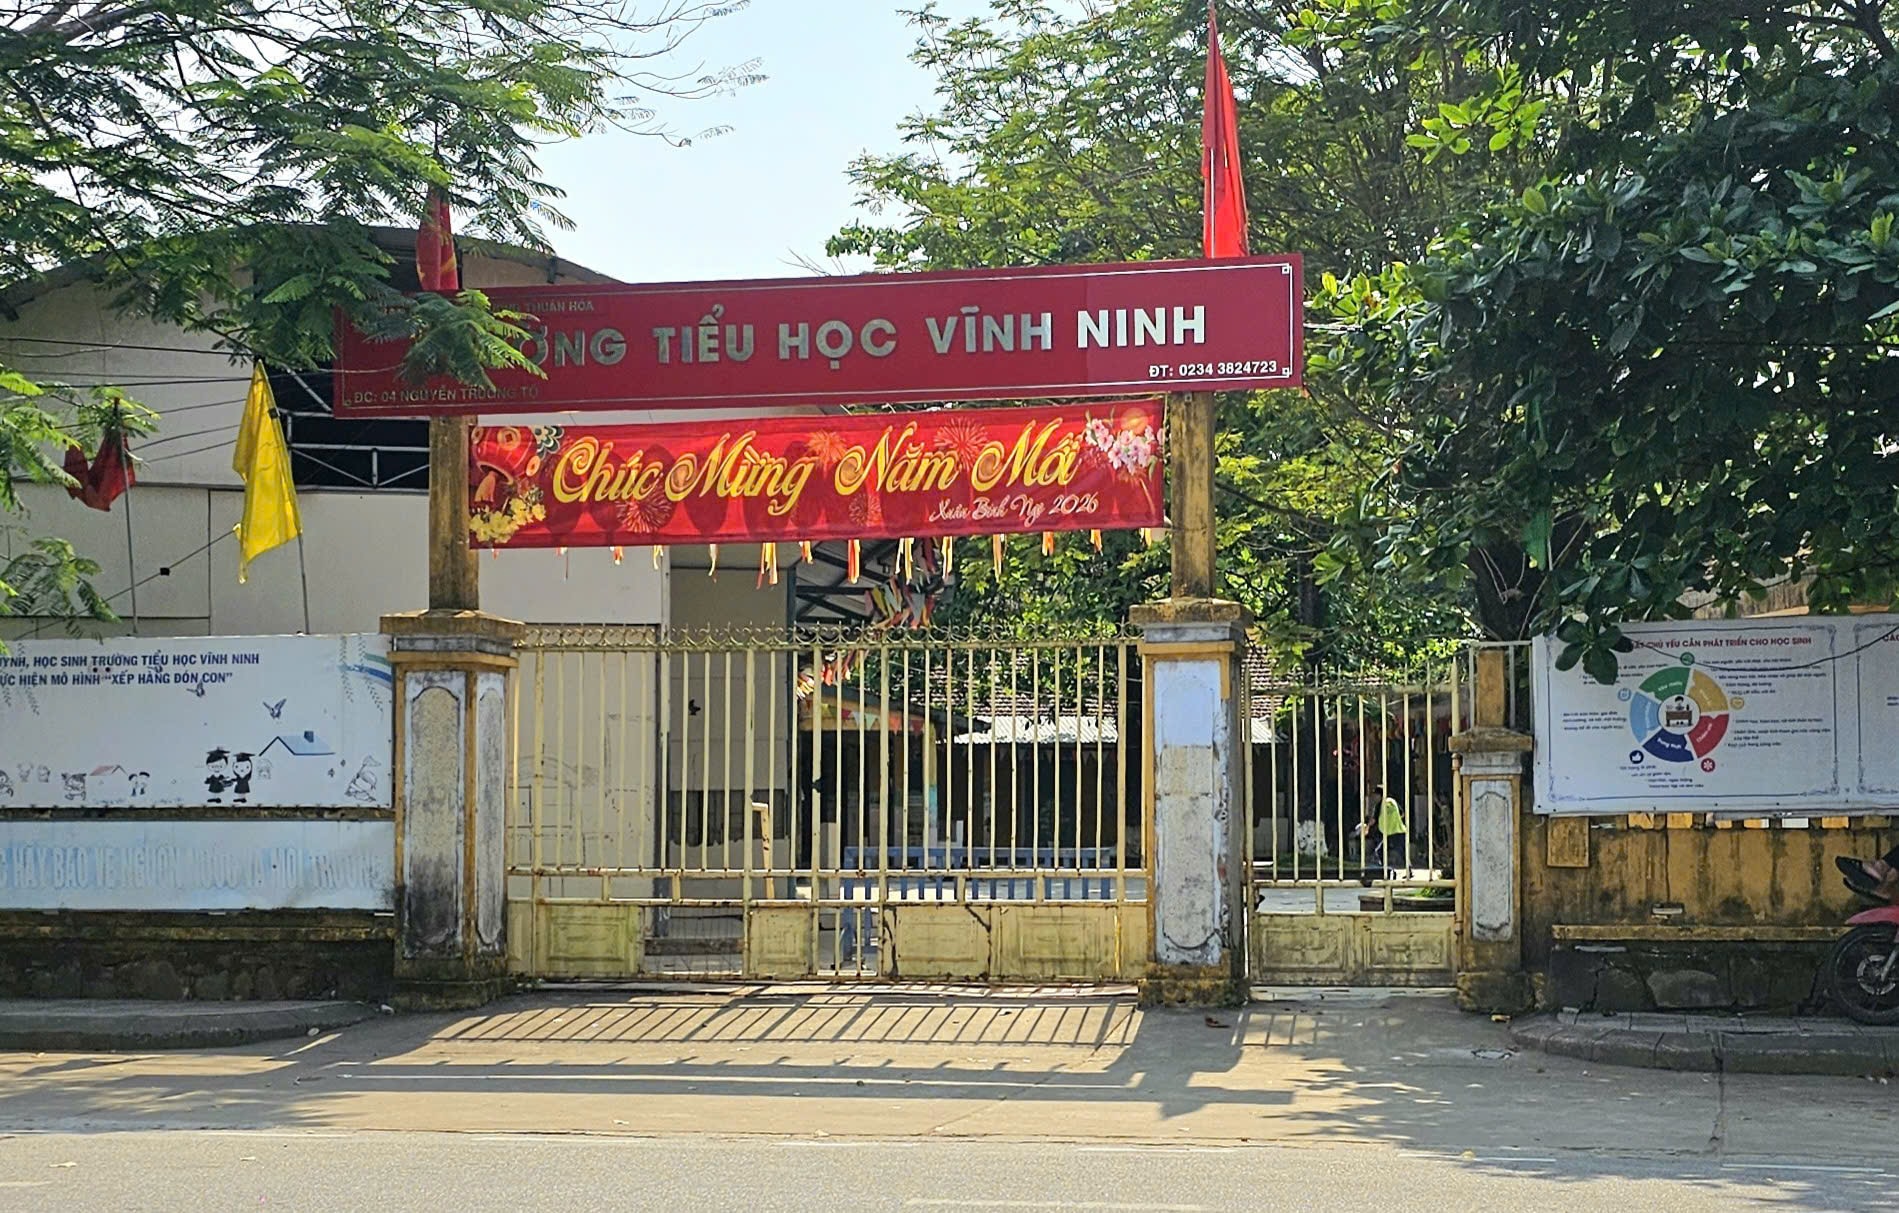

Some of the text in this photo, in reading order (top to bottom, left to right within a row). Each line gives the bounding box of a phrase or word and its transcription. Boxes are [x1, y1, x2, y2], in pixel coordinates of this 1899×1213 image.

[653, 303, 755, 365] TIỂU
[778, 317, 897, 370] HỌC
[925, 305, 1053, 354] VĨNH
[1076, 305, 1206, 348] NINH
[1148, 360, 1277, 377] ĐT: 0234 3824723
[354, 391, 378, 403] ĐC:
[381, 390, 396, 403] 04
[552, 417, 1087, 516] Chúc Mừng Năm Mới
[929, 498, 970, 522] Xuân
[1048, 491, 1099, 515] 2026
[1703, 637, 1724, 647] PHÁT
[1749, 638, 1769, 646] CHO
[1770, 637, 1789, 647] HỌC
[1792, 636, 1812, 645] SINH
[34, 656, 58, 669] HỌC
[61, 655, 88, 667] SINH
[91, 652, 138, 667] TRƯỜNG
[141, 649, 169, 666] TIỂU
[172, 653, 197, 668] HỌC
[200, 652, 228, 665] VĨNH
[232, 653, 260, 665] NINH
[19, 672, 48, 687] HIỆN
[51, 671, 69, 686] MÔ
[72, 671, 101, 686] HÌNH
[138, 670, 170, 685] HÀNG
[174, 670, 199, 684] ĐÓN
